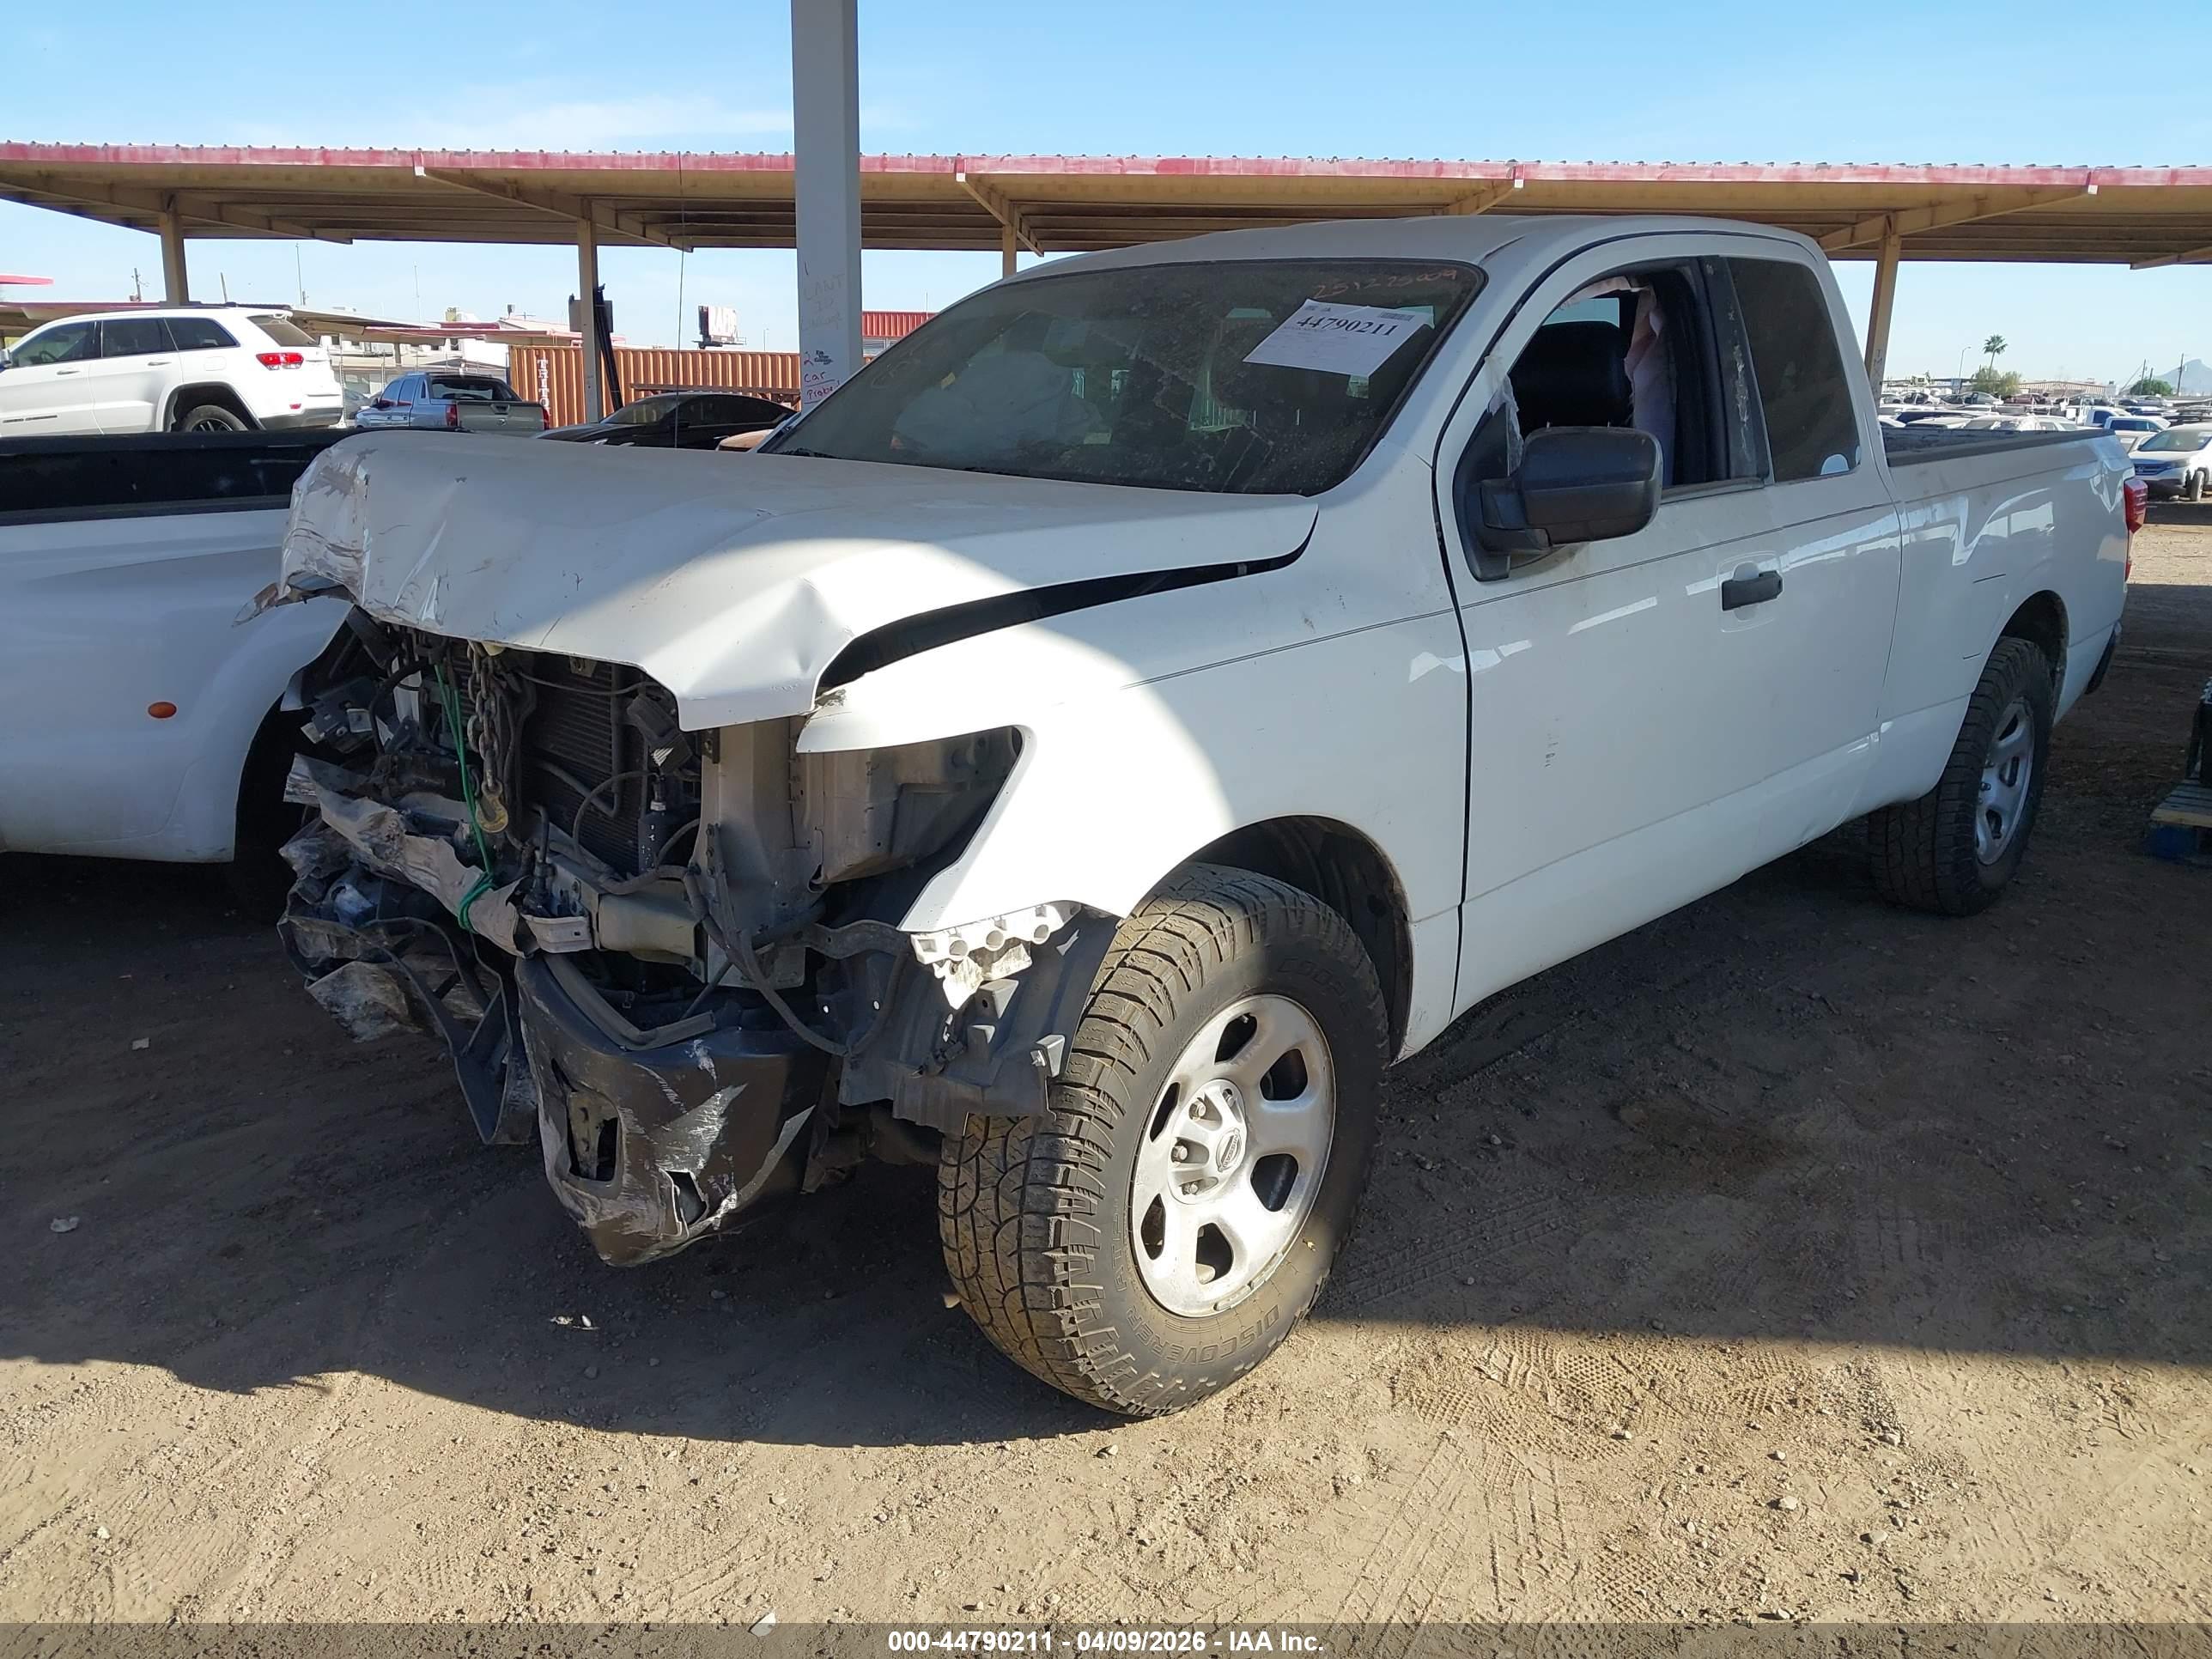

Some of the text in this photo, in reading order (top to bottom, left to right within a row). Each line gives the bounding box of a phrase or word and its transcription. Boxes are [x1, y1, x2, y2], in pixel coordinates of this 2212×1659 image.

[1297, 314, 1399, 337] 44790211
[538, 359, 550, 409] TRITO
[1125, 1304, 1280, 1365] DISCOVERER
